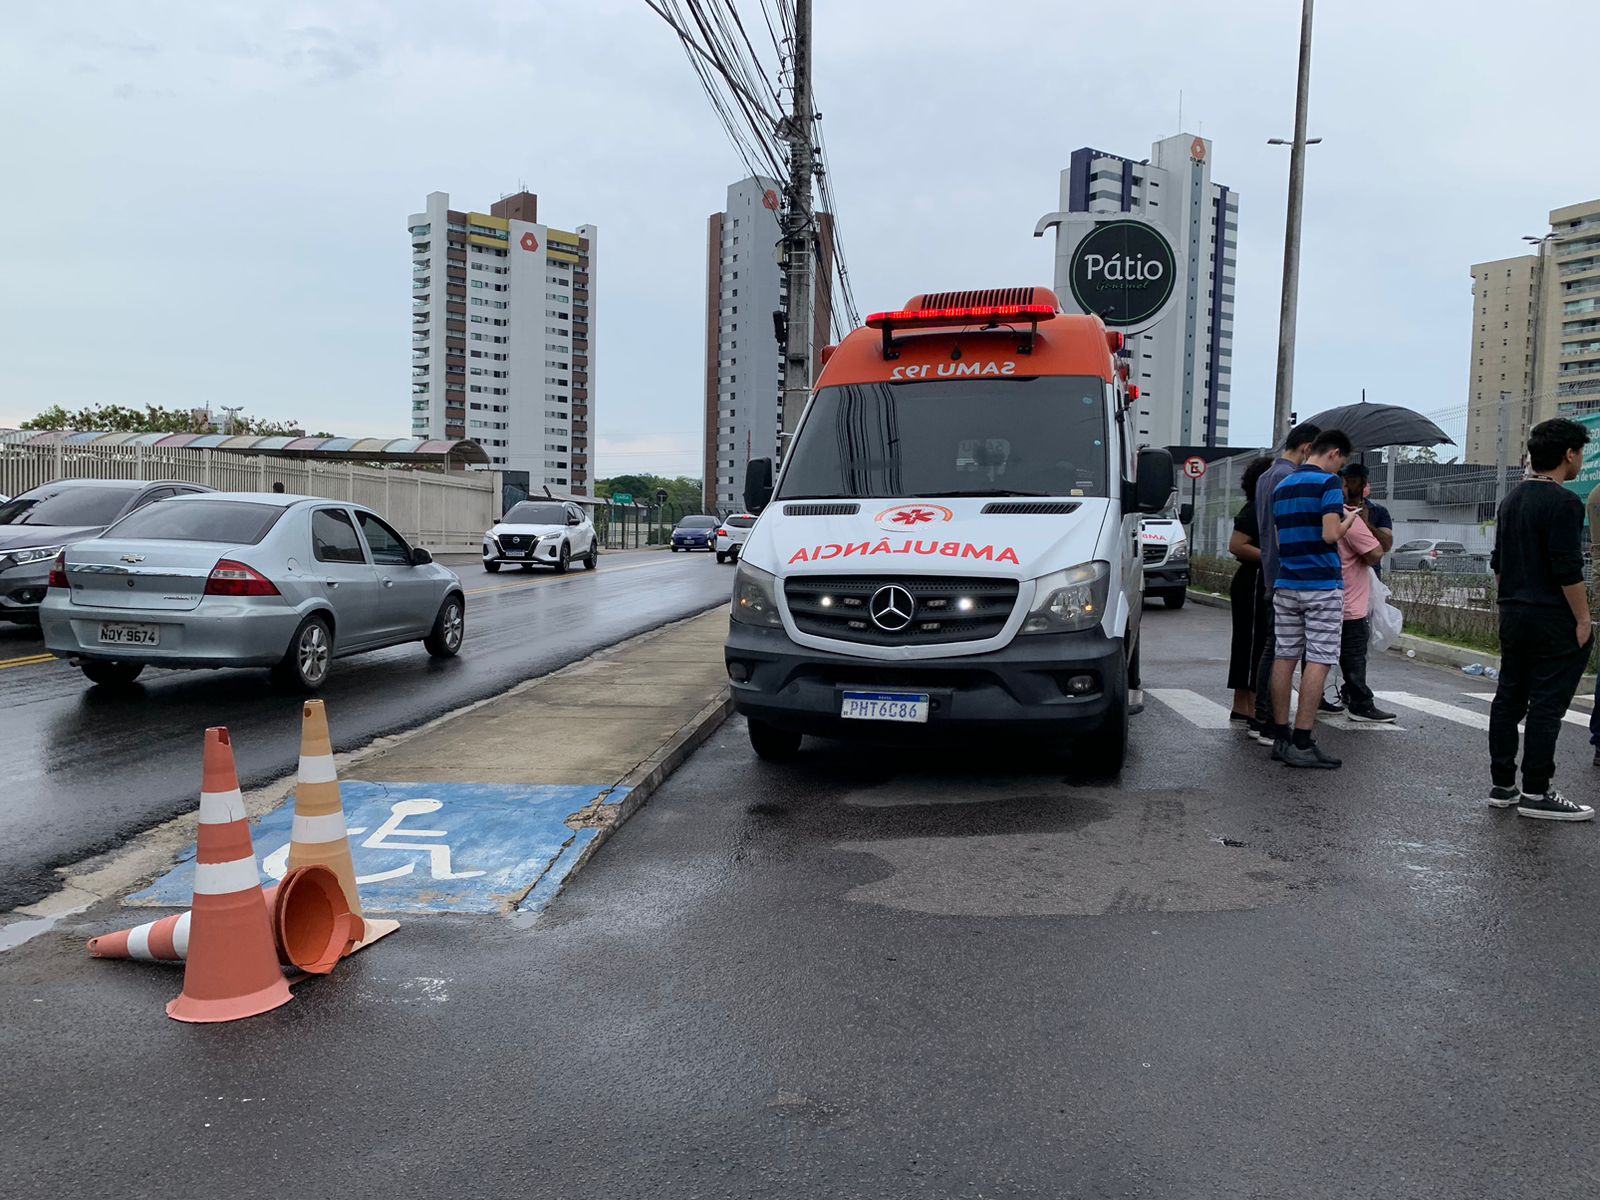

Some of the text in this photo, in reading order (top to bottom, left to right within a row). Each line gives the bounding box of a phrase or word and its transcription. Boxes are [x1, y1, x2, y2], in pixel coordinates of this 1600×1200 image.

[1084, 252, 1163, 280] Pátio
[1191, 462, 1199, 473] E
[849, 701, 917, 718] PHT6C86
